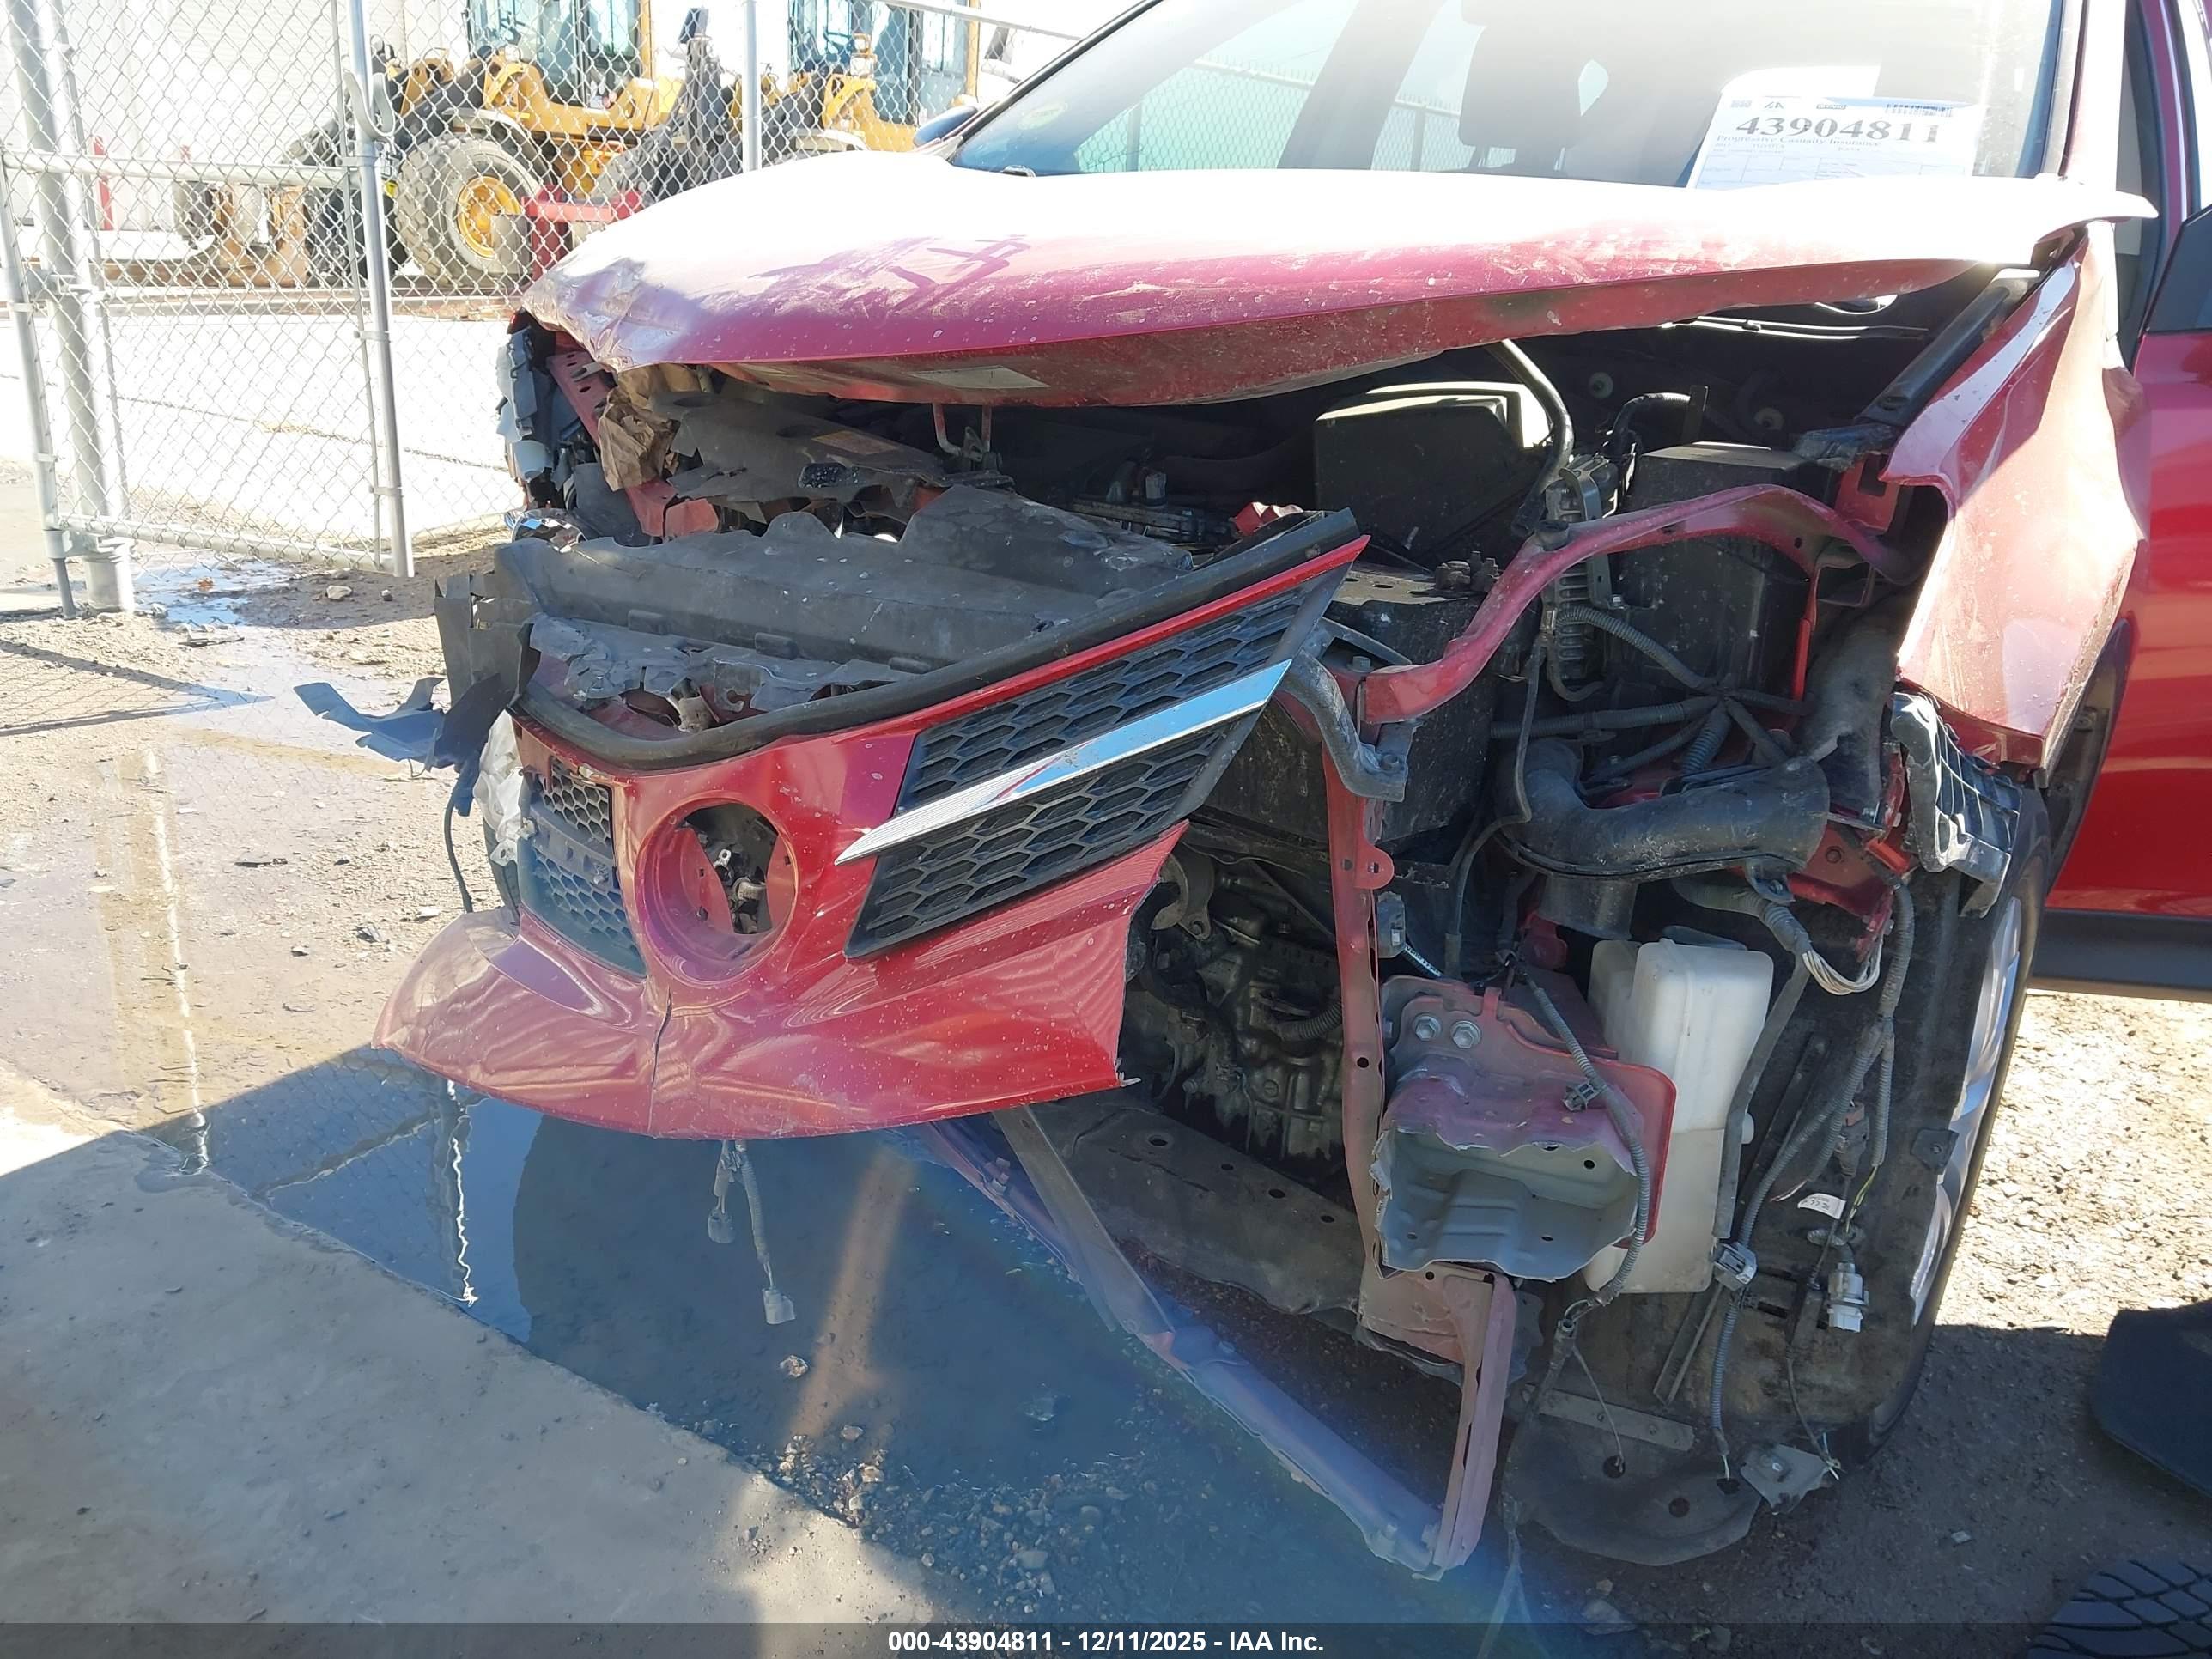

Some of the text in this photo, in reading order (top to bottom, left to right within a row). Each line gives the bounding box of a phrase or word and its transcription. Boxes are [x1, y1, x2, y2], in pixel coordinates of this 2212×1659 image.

[1735, 116, 1940, 143] 43904811
[1717, 135, 1778, 143] Progressive
[1829, 137, 1882, 147] Insurance
